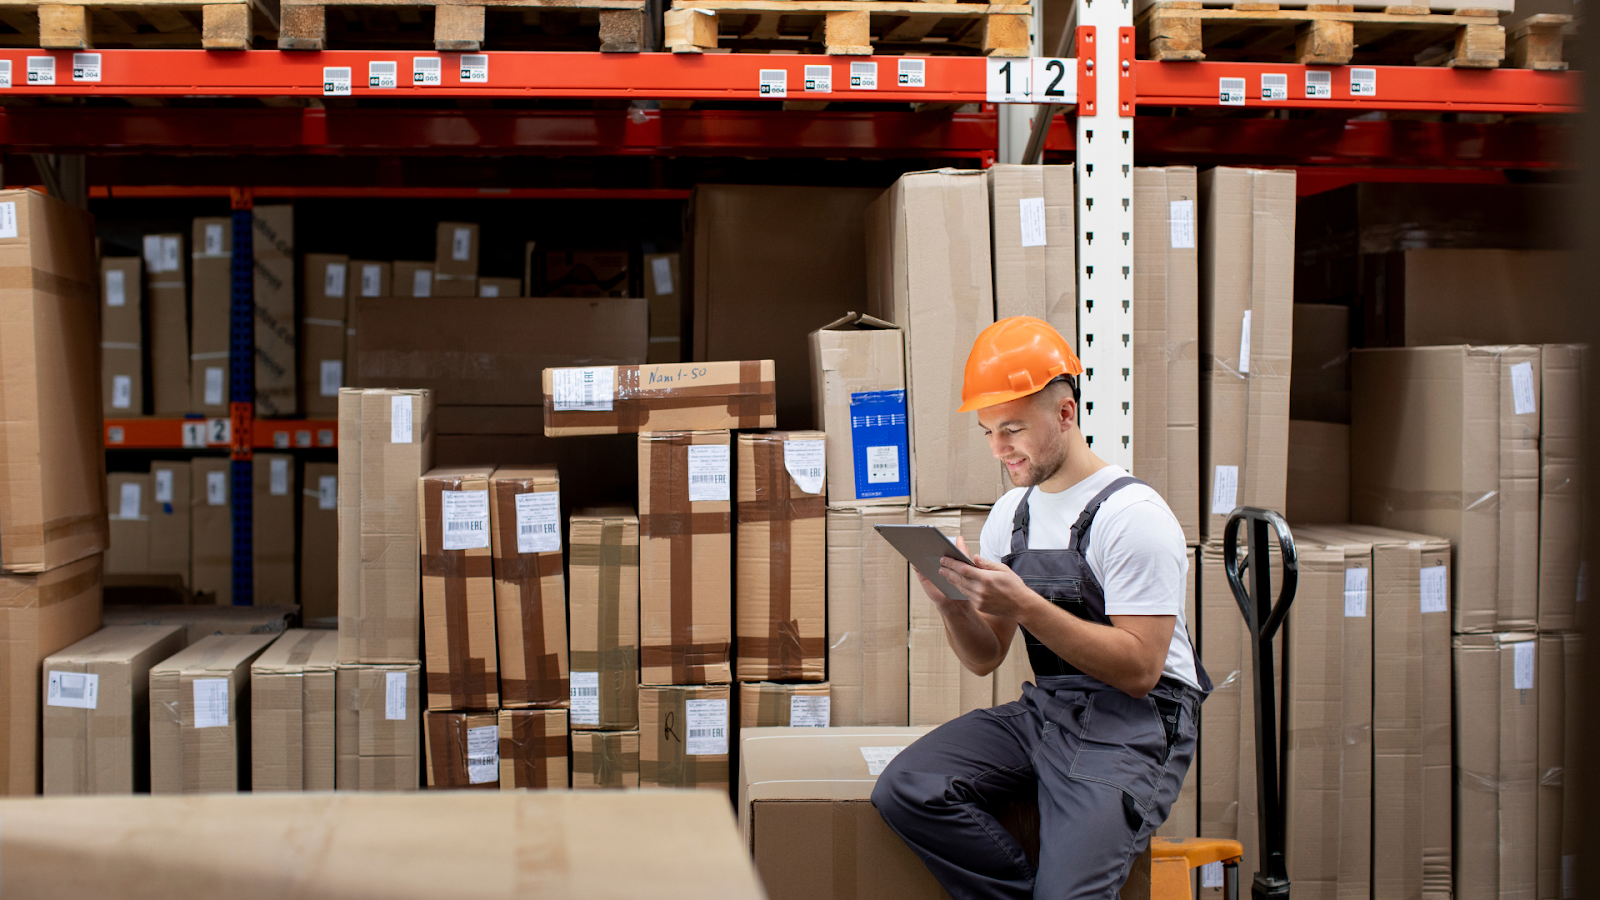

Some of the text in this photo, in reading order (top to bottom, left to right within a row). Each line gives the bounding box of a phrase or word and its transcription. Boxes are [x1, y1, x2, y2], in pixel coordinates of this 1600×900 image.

[998, 61, 1011, 94] 1
[1044, 60, 1065, 96] 2
[188, 424, 196, 443] 1
[214, 420, 225, 442] 2
